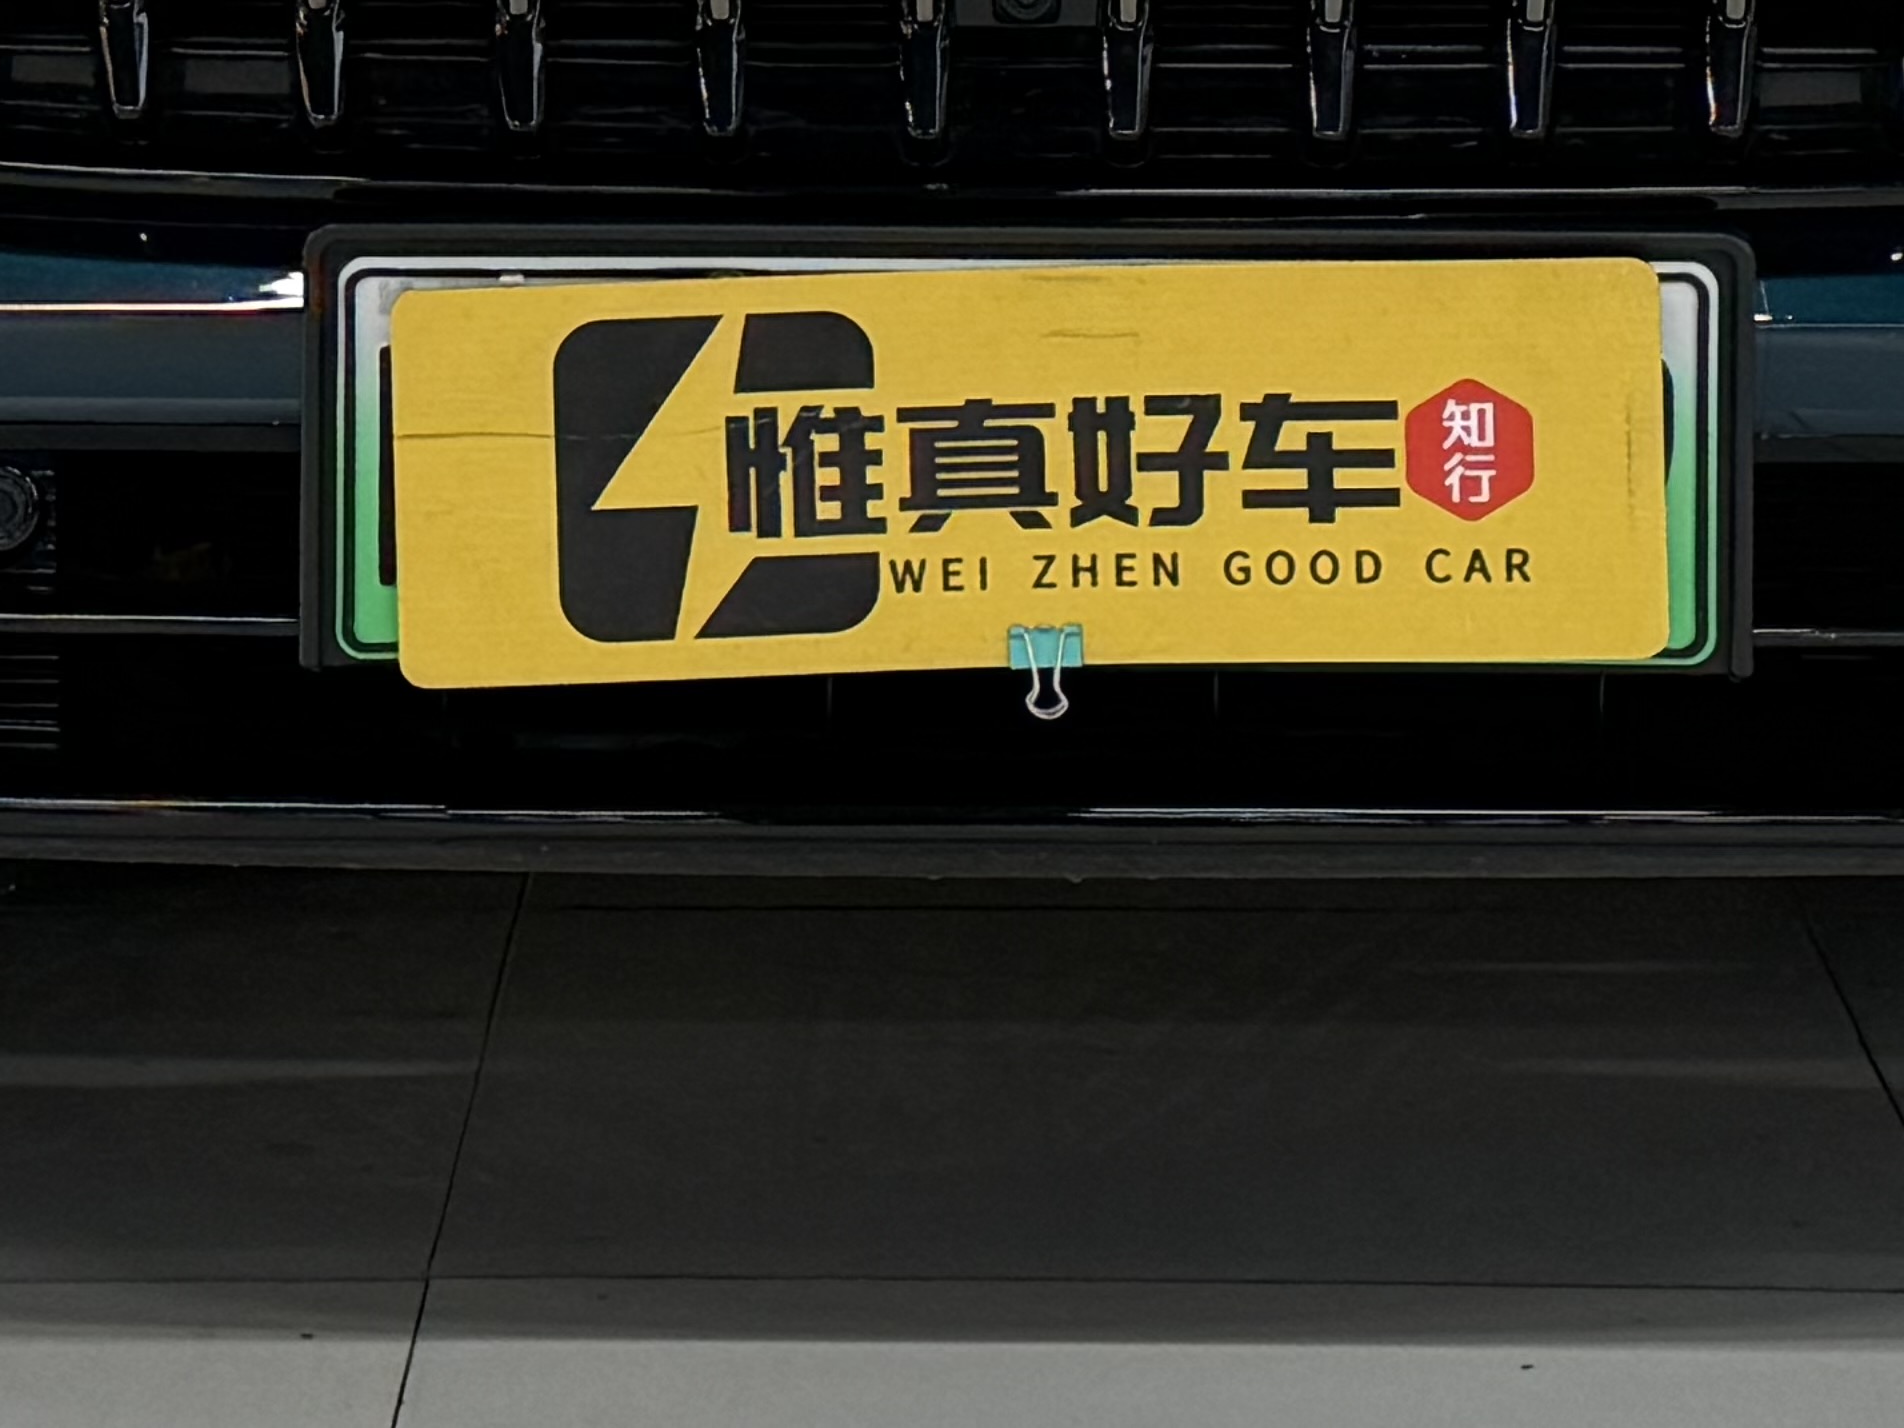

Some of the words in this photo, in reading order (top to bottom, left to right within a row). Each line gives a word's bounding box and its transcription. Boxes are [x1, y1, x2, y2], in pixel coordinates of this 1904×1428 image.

[724, 393, 1400, 538] 惟真好车
[1441, 398, 1497, 503] 知行
[888, 556, 988, 593] WEI
[1031, 551, 1180, 589] ZHEN
[1222, 548, 1383, 586] GOOD
[1424, 547, 1532, 584] CAR
